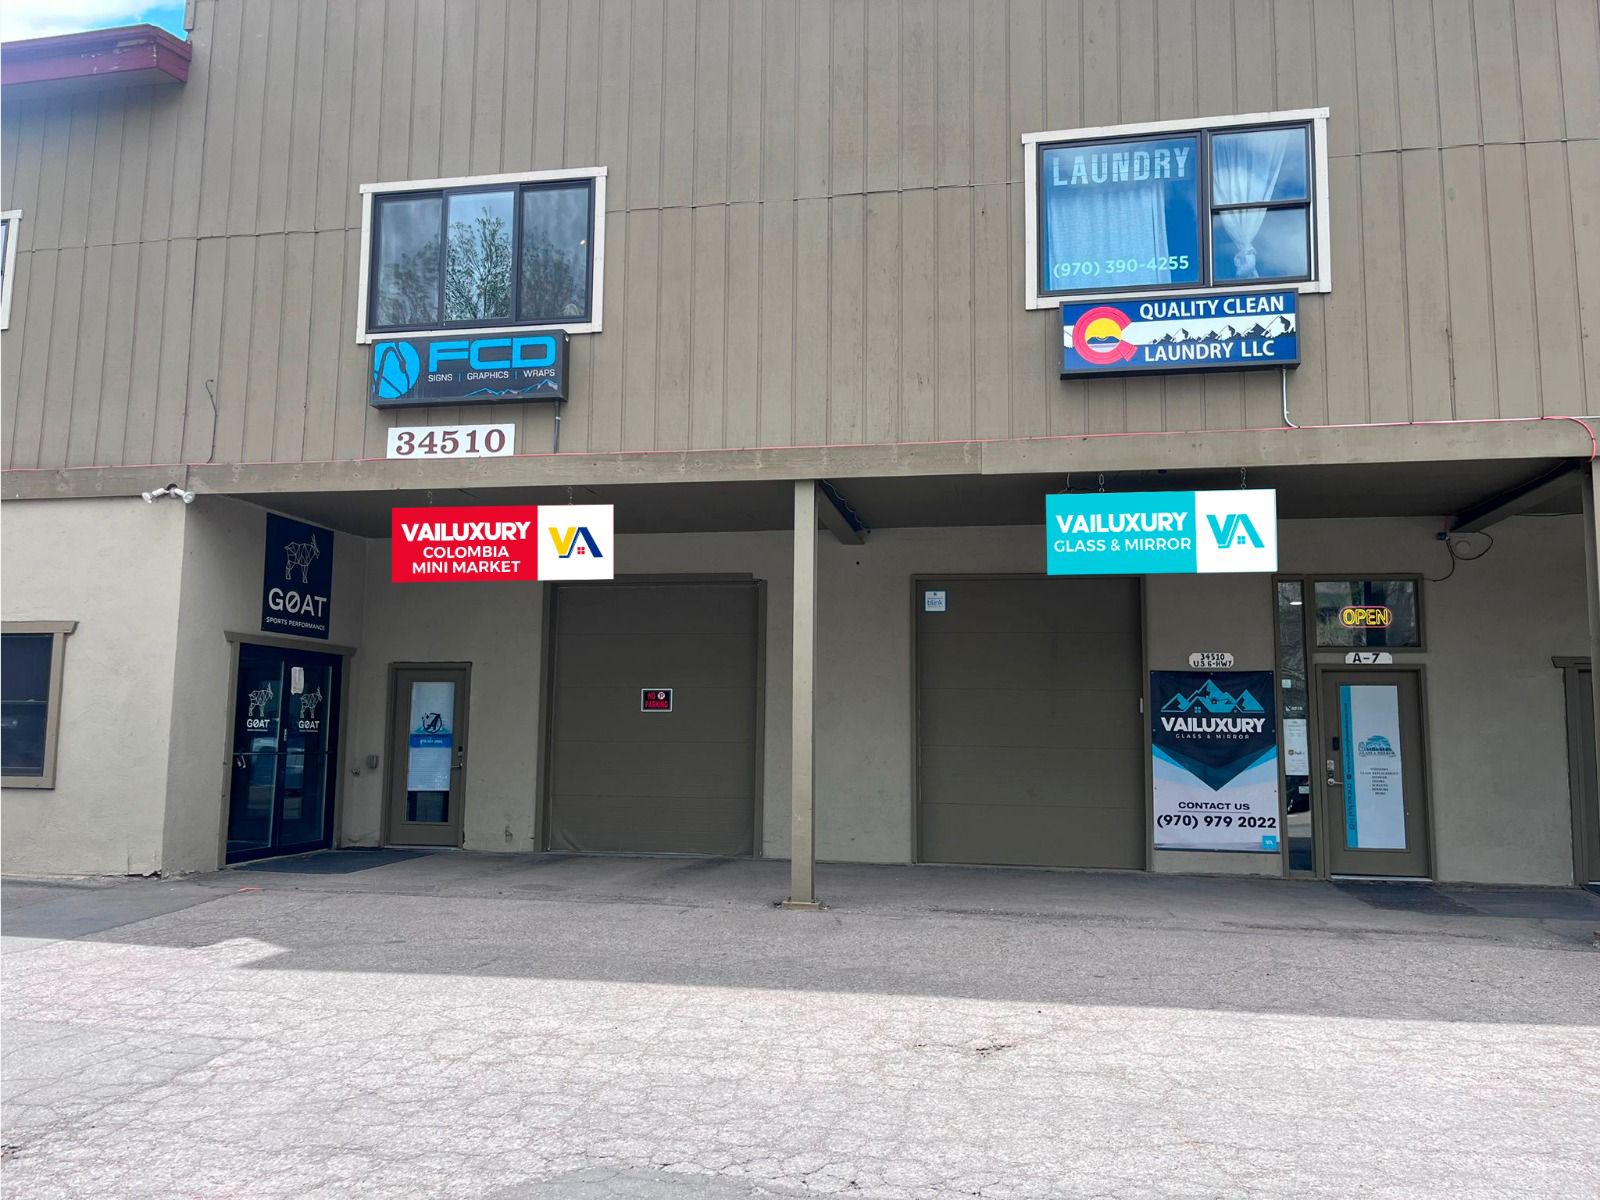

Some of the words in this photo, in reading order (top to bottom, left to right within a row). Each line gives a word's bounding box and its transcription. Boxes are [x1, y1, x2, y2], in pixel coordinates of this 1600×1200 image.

[1052, 146, 1191, 187] LAUNDRY
[1052, 260, 1101, 279] (970)
[1105, 255, 1190, 274] 390-4255
[1139, 298, 1220, 320] QUALITY
[1223, 295, 1285, 315] CLEAN
[428, 335, 556, 373] FCD
[1144, 341, 1235, 363] LAUNDRY
[1241, 339, 1275, 359] LLC
[427, 372, 453, 383] SIGNS
[466, 370, 509, 381] GRAPHICS
[523, 368, 556, 378] WRAPS
[395, 428, 506, 456] 34510
[1056, 511, 1188, 534] VAILUXURY
[401, 520, 532, 542] VAILUXURY
[422, 545, 510, 559] COLOMBIA
[1053, 538, 1106, 553] GLASS
[1110, 538, 1121, 552] &
[1125, 537, 1192, 551] MIRROR
[412, 560, 448, 574] MINI
[452, 560, 521, 574] MARKET
[266, 616, 288, 626] SPORTS
[288, 619, 325, 631] PERFORMANCE
[1343, 608, 1388, 625] OPEN
[1200, 653, 1225, 661] 34510
[1353, 652, 1380, 664] A-7
[647, 692, 656, 700] NO
[645, 700, 669, 709] PARKING
[1160, 716, 1266, 733] VAILUXURY
[1178, 801, 1231, 811] CONTACT
[1234, 802, 1250, 811] US
[1157, 814, 1198, 829] (970)
[1204, 815, 1233, 828] 979
[1238, 816, 1277, 829] 2022
